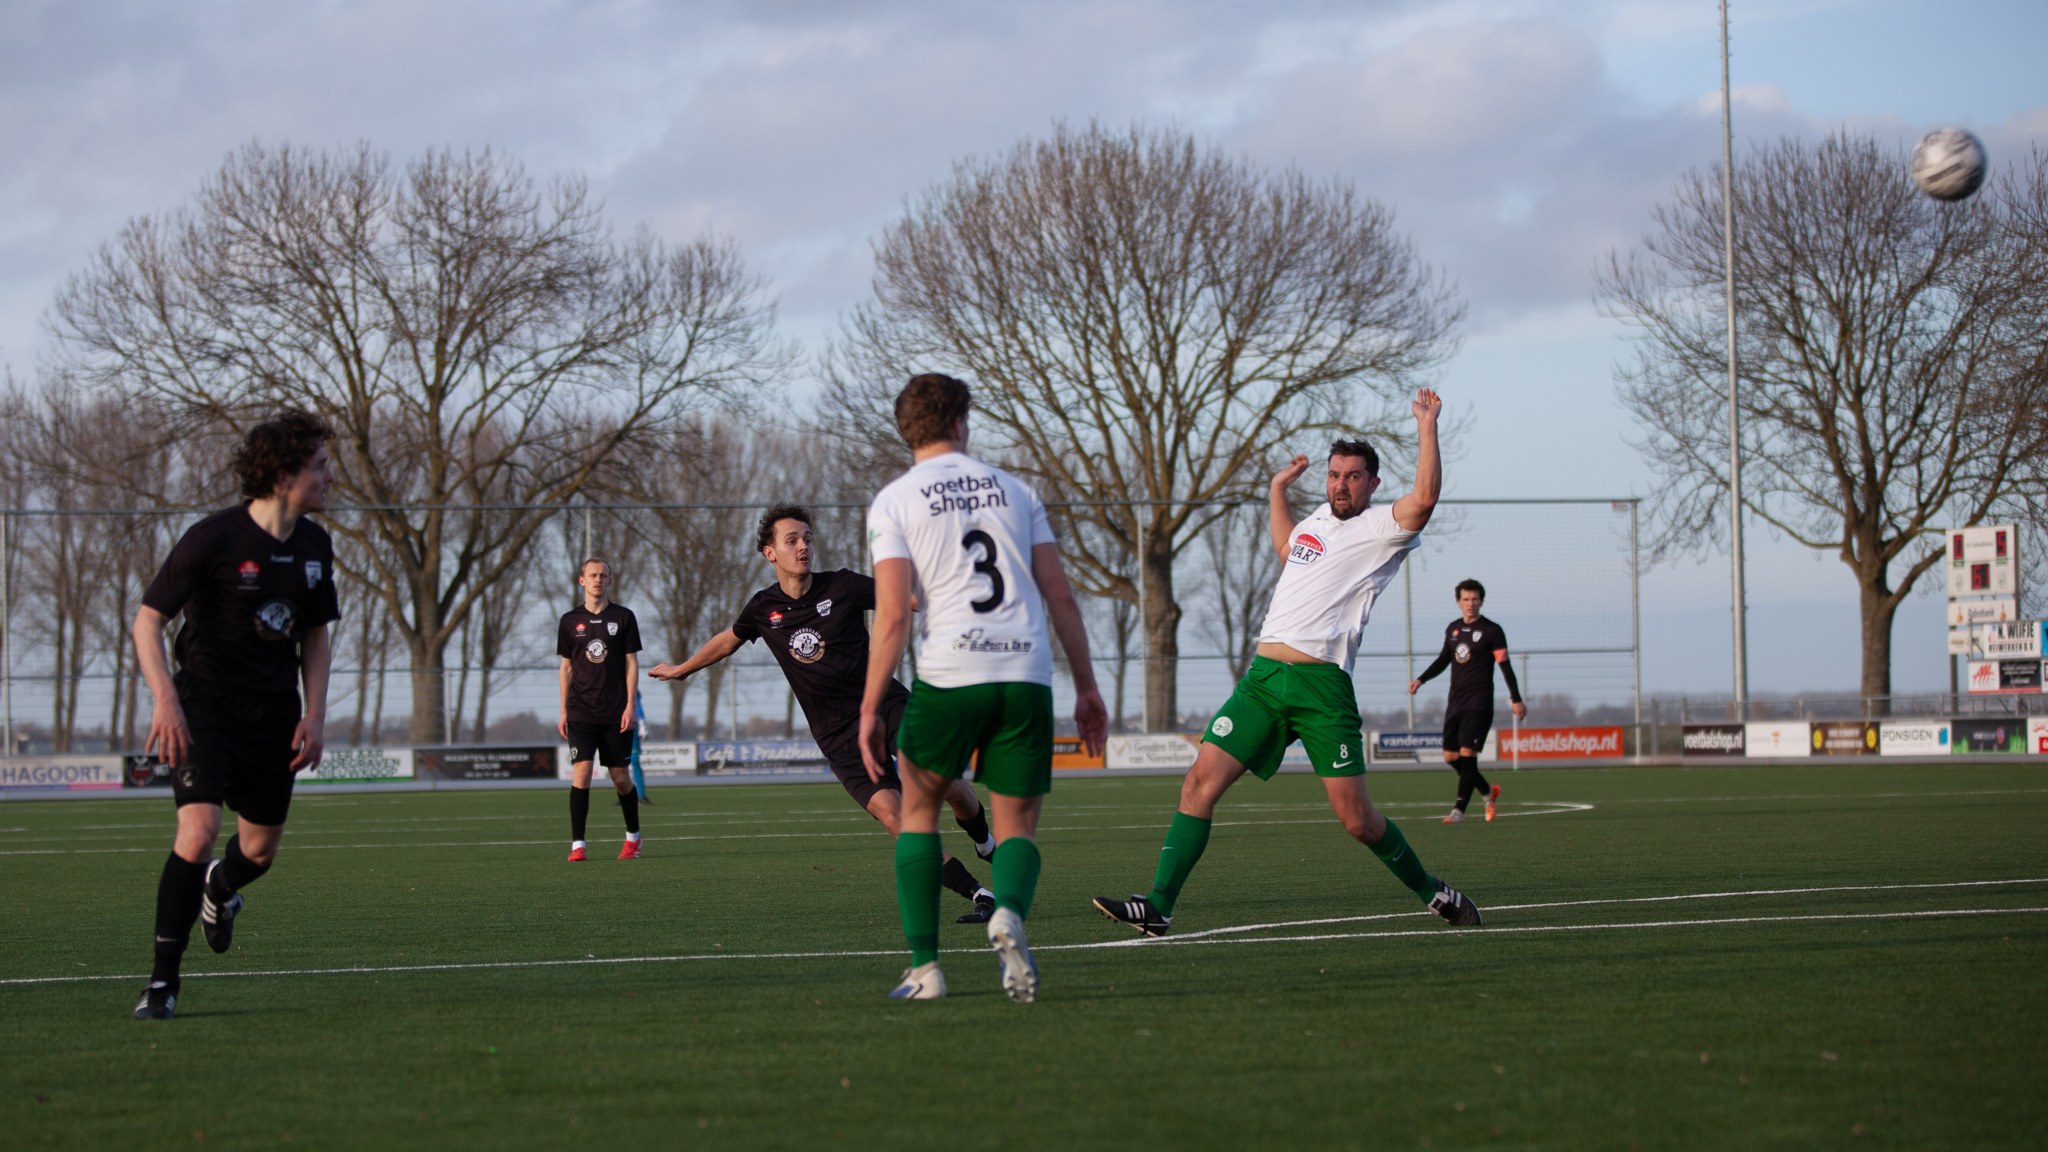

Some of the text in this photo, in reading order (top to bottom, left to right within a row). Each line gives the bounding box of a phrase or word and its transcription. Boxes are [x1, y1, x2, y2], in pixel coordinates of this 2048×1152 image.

[920, 474, 1002, 499] voetbal
[929, 490, 1008, 516] shop.nl
[1954, 534, 1963, 559] 0
[1997, 531, 2006, 557] 5
[961, 529, 1005, 615] 3
[1972, 564, 1989, 590] 61
[1968, 608, 1994, 618] Rabobank
[788, 628, 822, 646] BUSINESSCLUB
[1339, 744, 1349, 759] 8
[1502, 730, 1618, 755] voetbalshop.nl
[1683, 727, 1742, 752] voetbalshop.nl
[2, 765, 104, 784] HAGOORT
[318, 758, 401, 770] ODEGRAVEN
